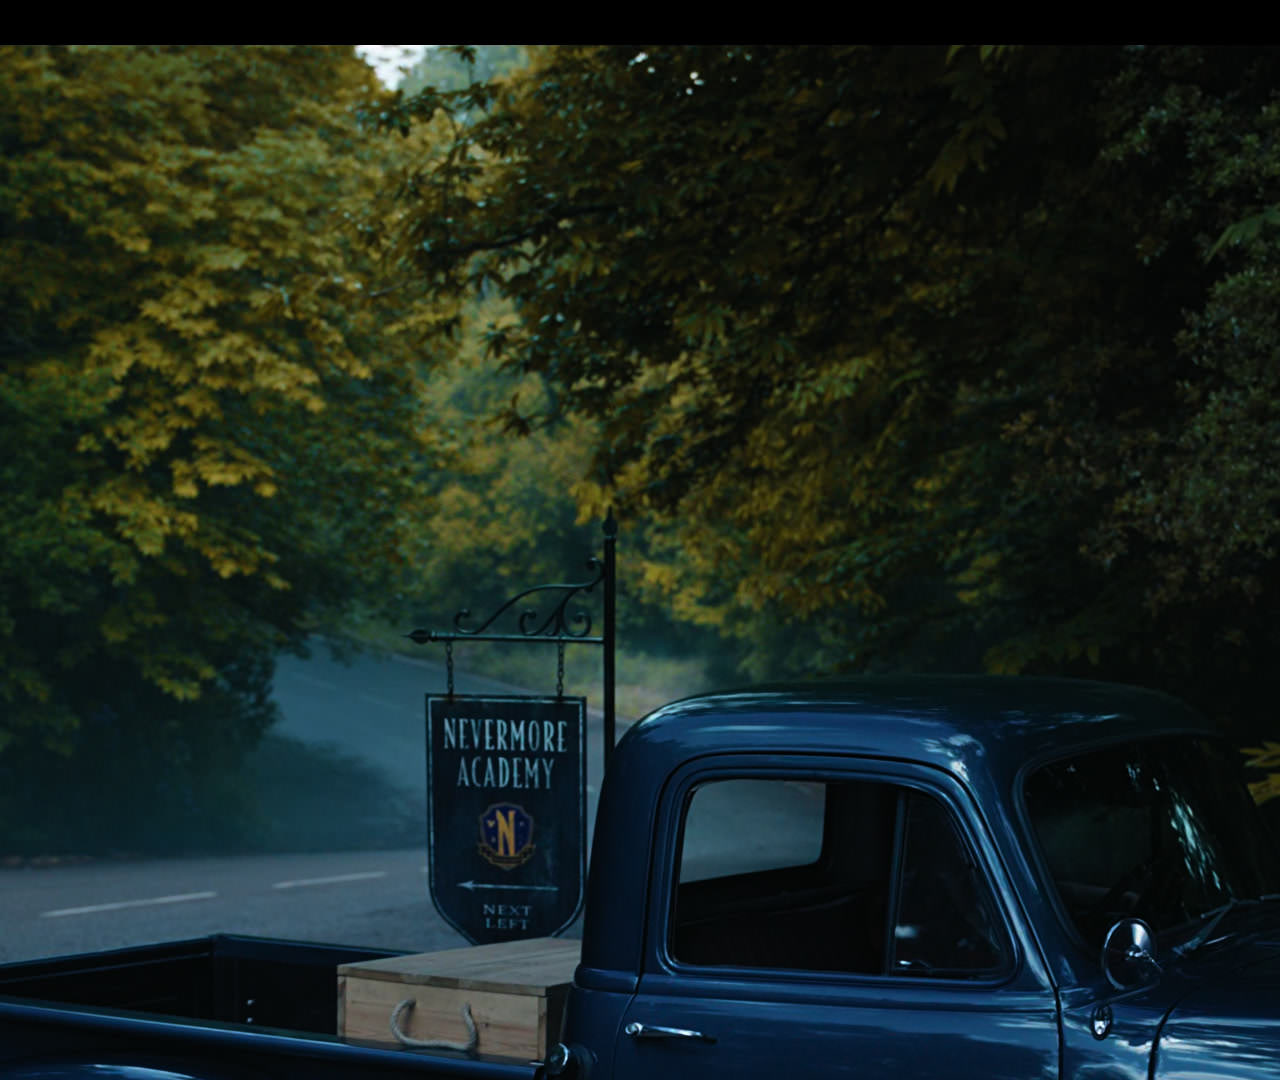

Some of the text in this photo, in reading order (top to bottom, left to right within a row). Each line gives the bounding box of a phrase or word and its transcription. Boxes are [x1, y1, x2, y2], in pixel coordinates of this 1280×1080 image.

[443, 717, 568, 753] NEVERMORE
[457, 756, 556, 790] ACADEMY
[495, 808, 517, 857] N
[483, 903, 533, 917] NEXT
[485, 917, 530, 930] LEFT
